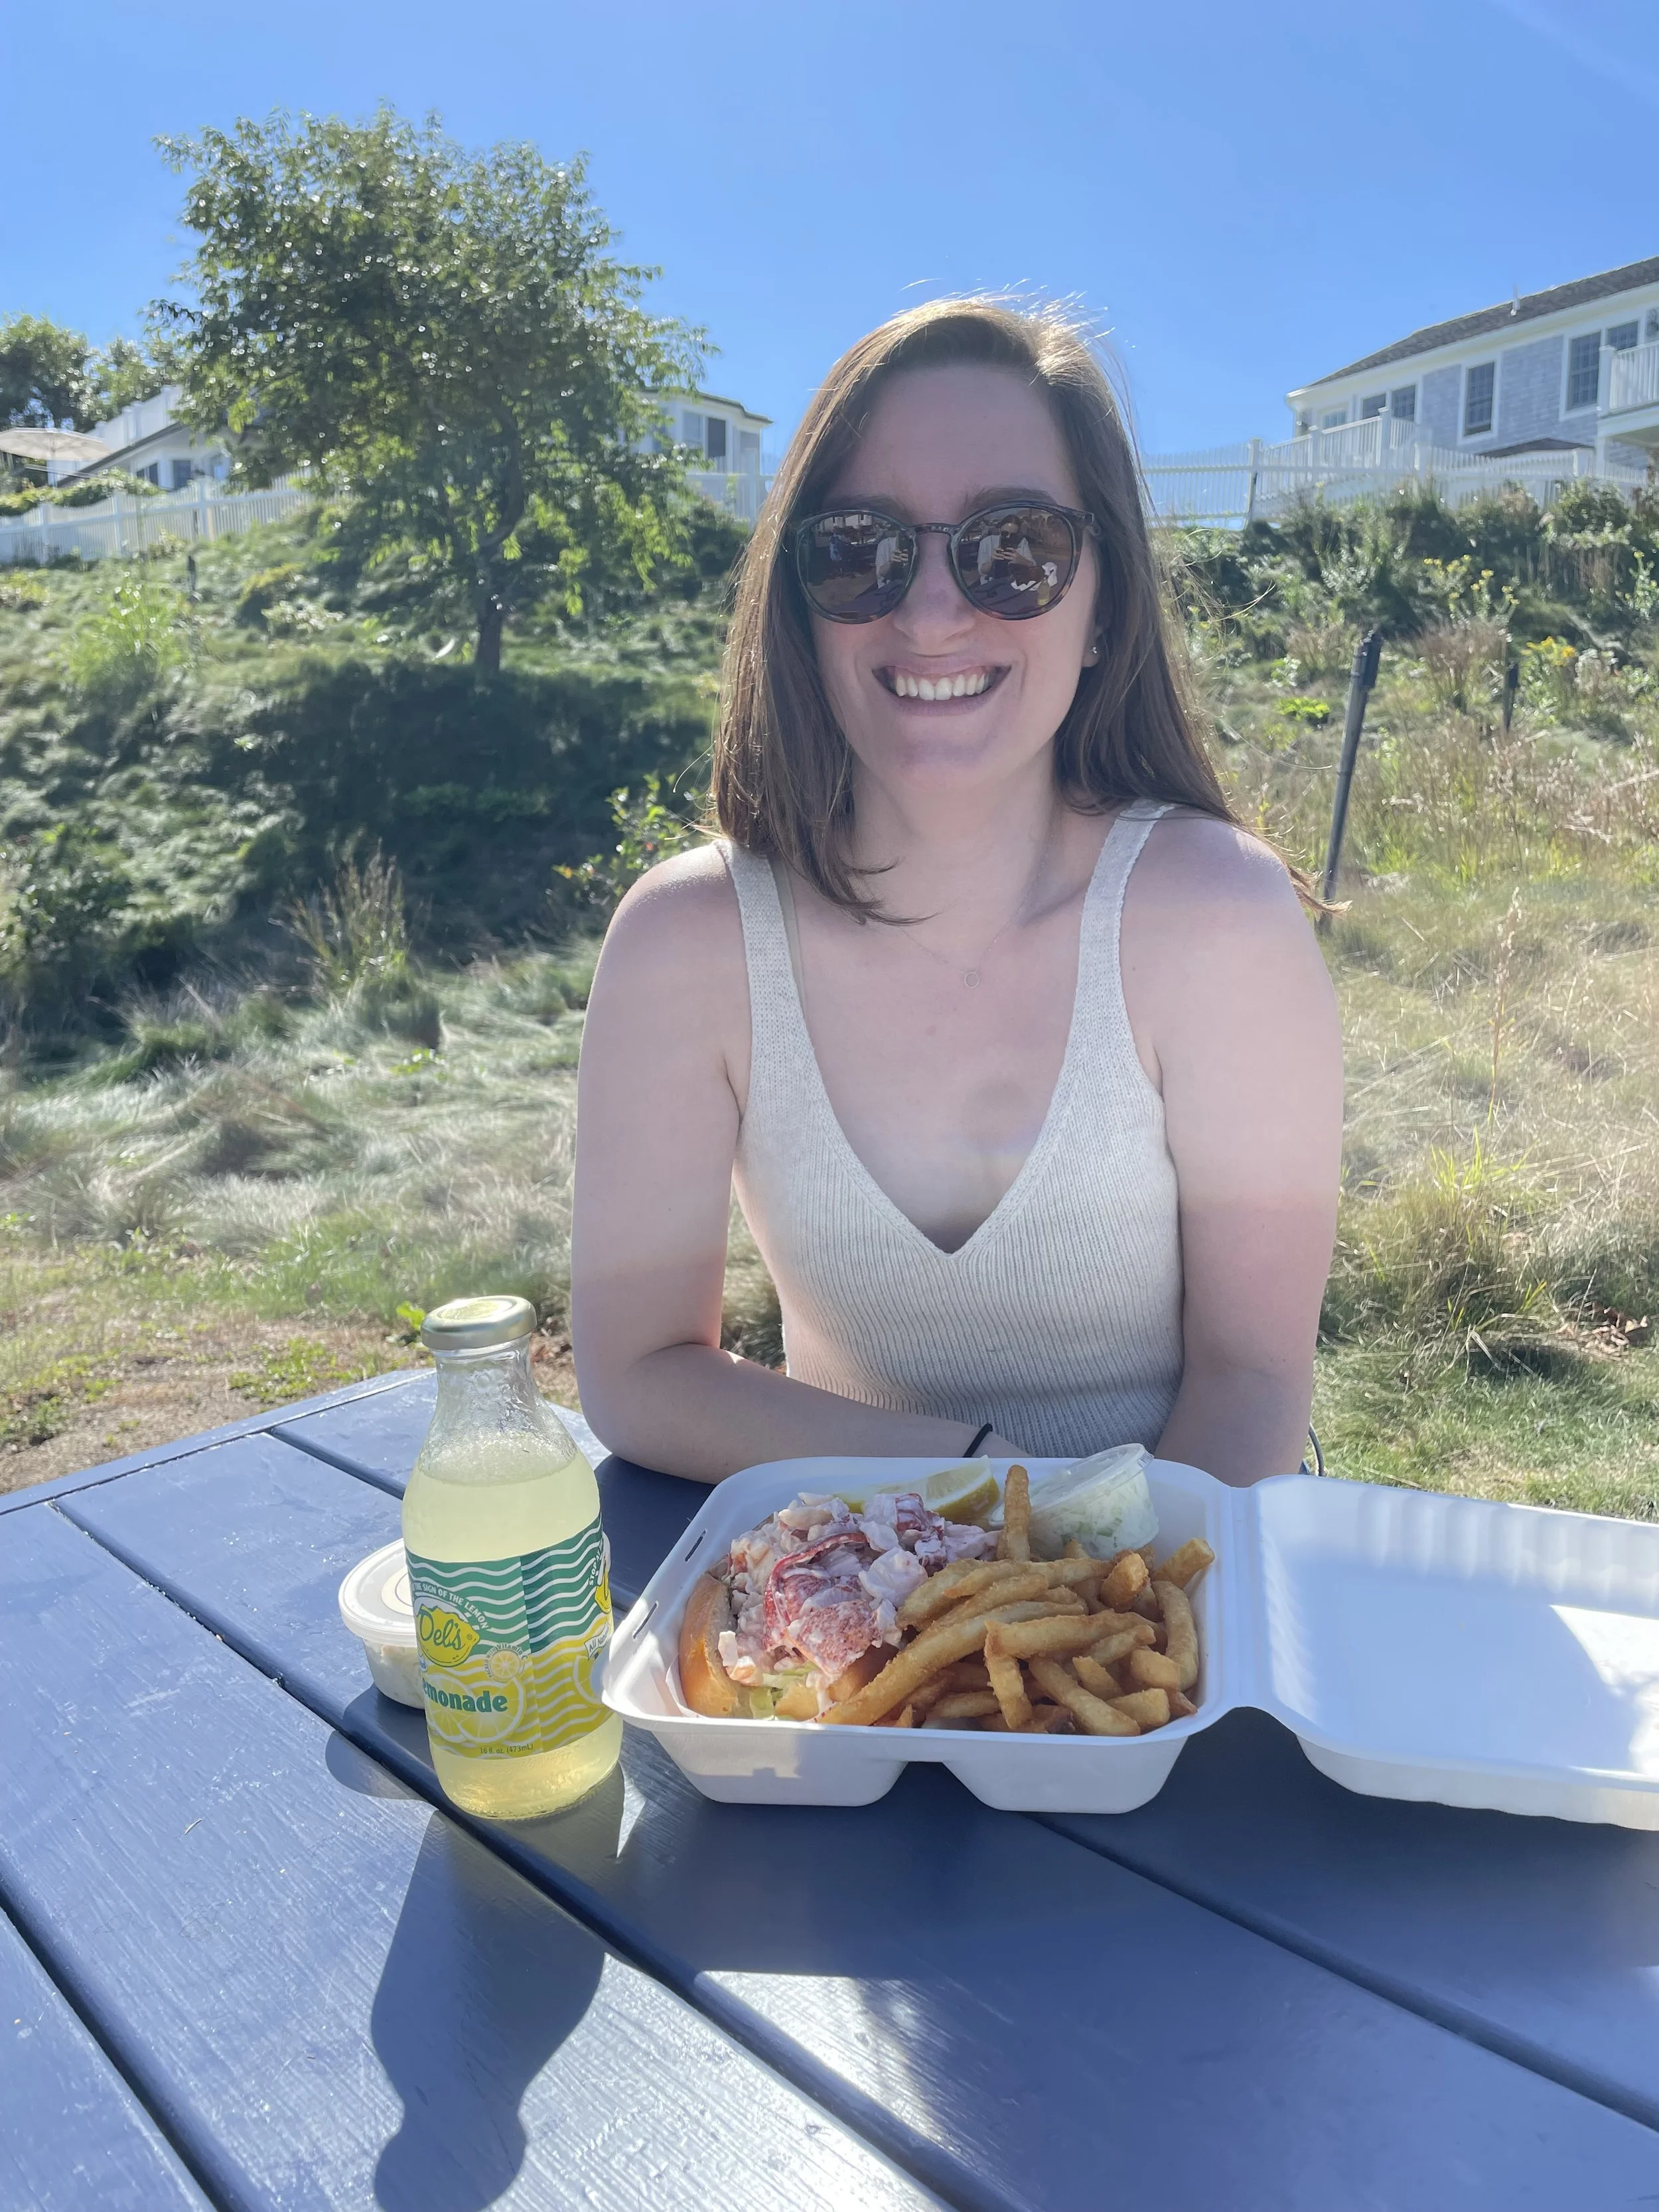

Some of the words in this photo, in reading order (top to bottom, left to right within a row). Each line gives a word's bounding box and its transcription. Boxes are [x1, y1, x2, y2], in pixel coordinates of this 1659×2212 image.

[422, 1584, 436, 1594] SIGN
[438, 1589, 449, 1598] OF
[449, 1592, 465, 1606] THE
[465, 1601, 489, 1631] LEMON
[419, 1609, 466, 1651] Del's
[497, 1643, 523, 1655] Vitamin
[423, 1678, 508, 1713] emonade
[506, 1743, 534, 1753] (473mL)
